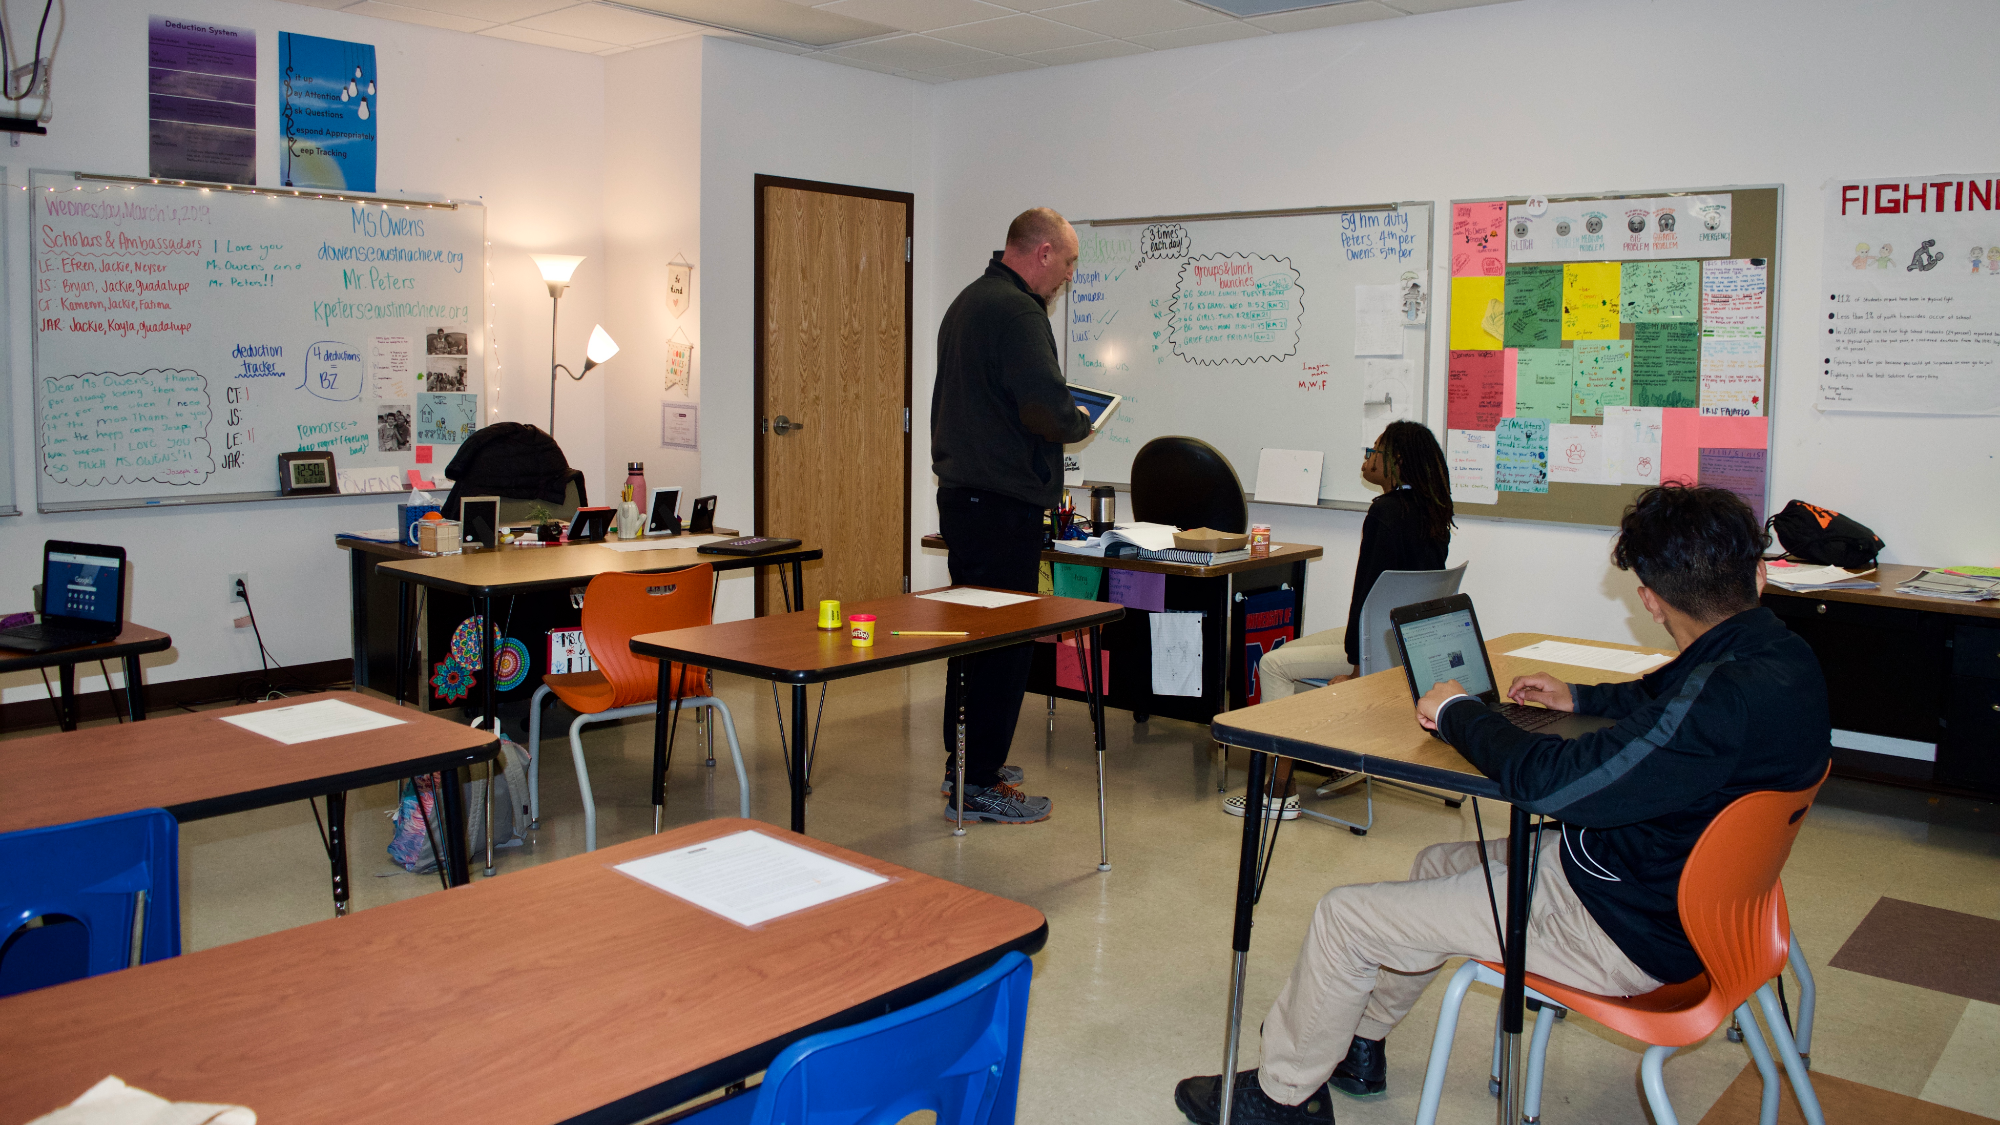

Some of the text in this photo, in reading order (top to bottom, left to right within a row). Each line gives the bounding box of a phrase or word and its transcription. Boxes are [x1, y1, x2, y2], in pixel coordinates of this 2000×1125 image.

[165, 20, 238, 38] Deduction System
[304, 76, 314, 84] up
[305, 90, 341, 102] Attention
[305, 108, 344, 119] Questions
[325, 128, 375, 142] Appropriately
[315, 147, 348, 159] Tracking
[1842, 178, 2000, 216] FIGHTIN
[124, 201, 166, 222] March
[180, 205, 212, 225] 2019
[379, 209, 426, 238] Owens
[1383, 211, 1409, 233] duty
[42, 224, 203, 251] Scholars & Ambassadors
[1149, 227, 1179, 241] 3 times
[1379, 229, 1399, 247] 4th
[1398, 233, 1417, 251] per
[1698, 232, 1731, 242] EMERGENCY
[213, 239, 285, 261] I Love you
[1150, 237, 1184, 254] each day!
[1622, 242, 1650, 252] PROBLEM
[317, 241, 464, 273] dowens@austinachieve.org
[1379, 247, 1397, 260] 5th
[1398, 247, 1415, 264] per
[98, 260, 133, 275] Jackie,
[134, 261, 168, 276] Neyser
[224, 259, 265, 271] Owens
[273, 261, 302, 271] and
[368, 265, 416, 291] Peters
[1219, 276, 1255, 290] bunches
[101, 280, 136, 294] Jackie,
[670, 285, 683, 295] kind
[107, 296, 139, 312] Jackie,
[138, 298, 173, 311] Fatima
[1229, 302, 1244, 310] WED
[1836, 311, 1850, 320] Less
[1852, 311, 1864, 320] than
[69, 317, 108, 336] Jackie,
[107, 318, 140, 338] Kayla,
[231, 343, 284, 359] deduction
[313, 346, 362, 362] 4 deductions
[672, 349, 686, 359] GOOD
[240, 359, 277, 374] tracker
[671, 358, 685, 369] VIBES
[46, 379, 75, 394] Dear
[103, 376, 155, 388] Owens,
[319, 371, 339, 390] BZ
[47, 398, 65, 409] for
[112, 388, 143, 399] being
[44, 411, 69, 421] care
[75, 407, 94, 417] for
[103, 404, 119, 412] me
[189, 410, 208, 421] you
[1702, 406, 1718, 416] IRIS
[73, 430, 90, 441] the
[296, 420, 348, 440] remorse
[316, 437, 338, 450] regret
[74, 575, 92, 585] Google
[1284, 606, 1293, 624] OF
